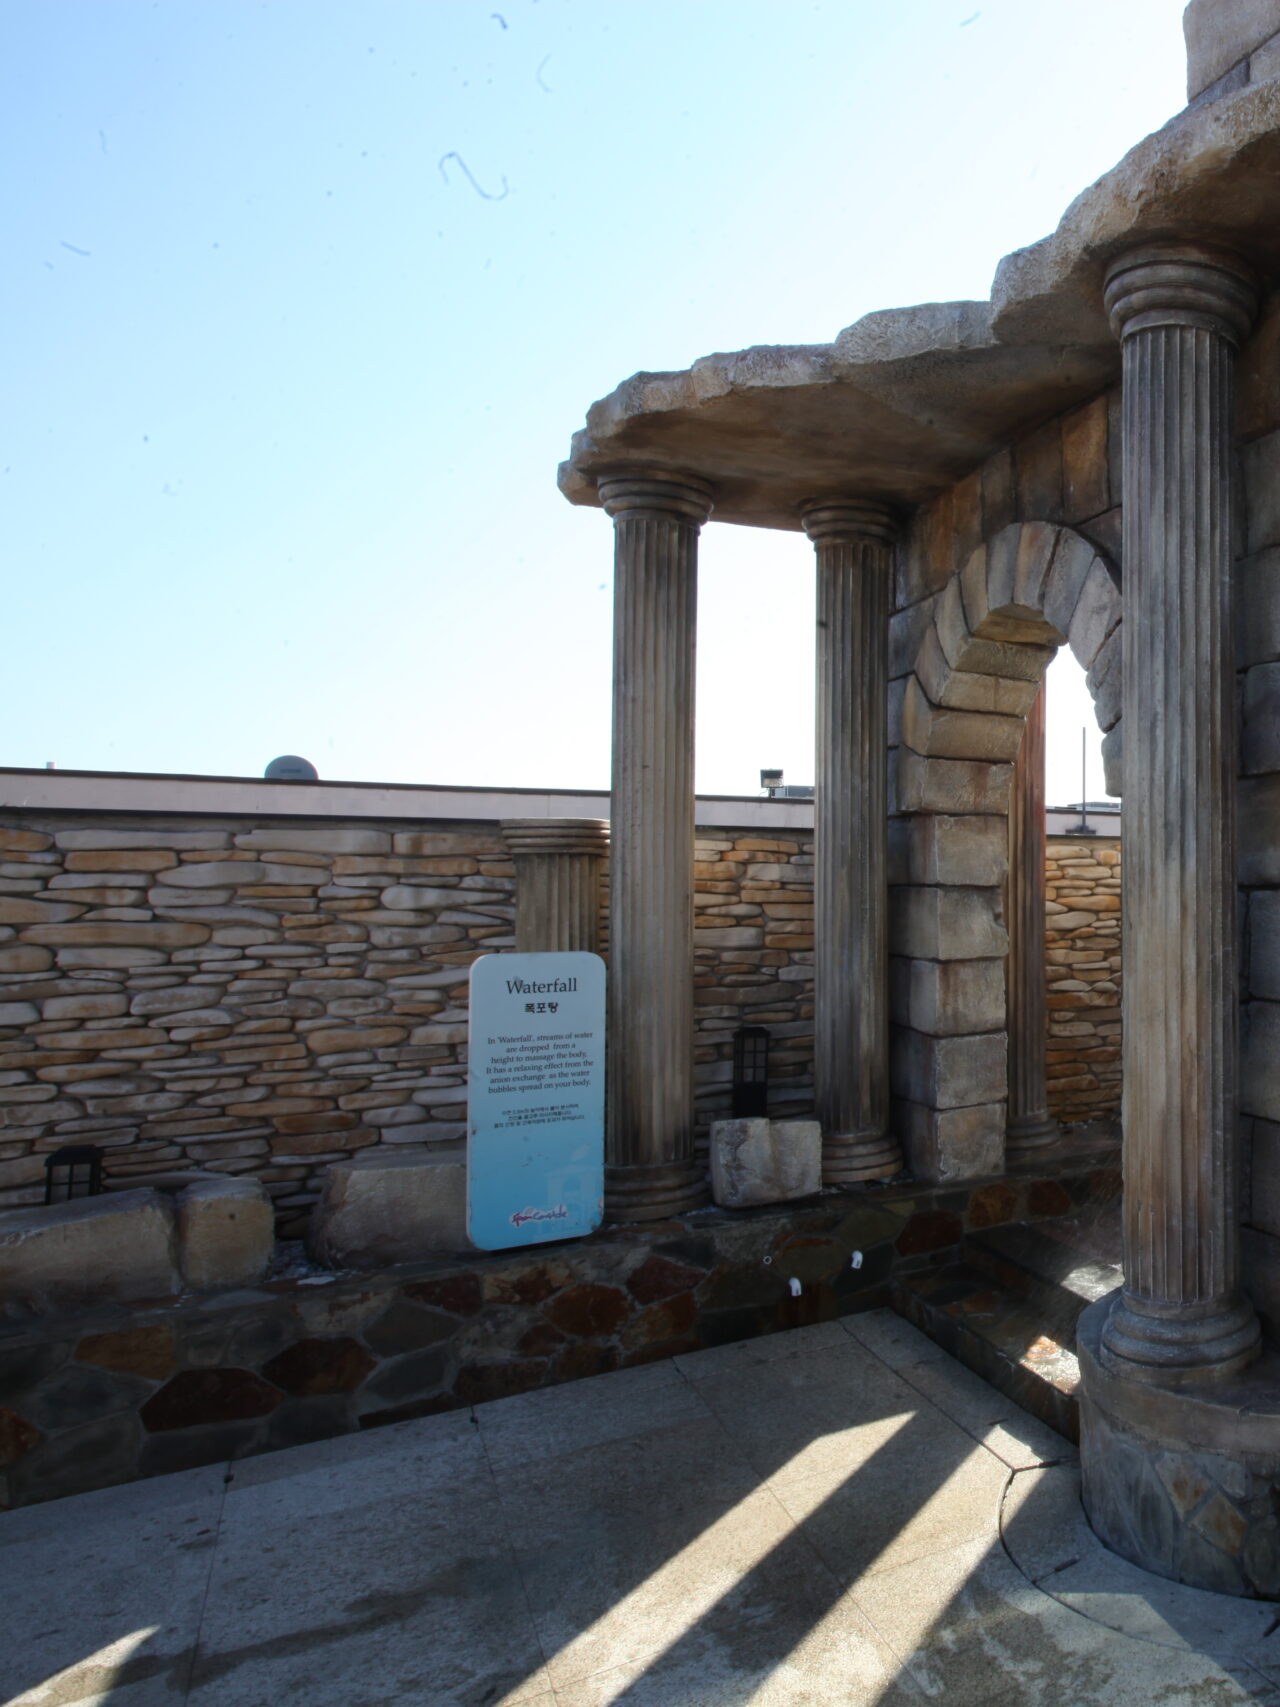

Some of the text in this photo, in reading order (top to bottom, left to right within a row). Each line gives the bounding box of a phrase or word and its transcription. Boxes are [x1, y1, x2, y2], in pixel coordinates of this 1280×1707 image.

[506, 977, 578, 995] Waterfall
[525, 1001, 559, 1014] 폭포탕
[487, 1037, 496, 1045] In
[537, 1033, 564, 1041] streams
[565, 1031, 573, 1039] of
[574, 1031, 593, 1039] water
[519, 1043, 550, 1054] dropped
[553, 1042, 570, 1050] from
[491, 1056, 514, 1065] height
[525, 1053, 555, 1063] massage
[556, 1050, 568, 1059] the
[486, 1067, 492, 1075] It
[493, 1066, 506, 1074] has
[513, 1064, 543, 1074] relaxing
[544, 1062, 563, 1070] effect
[564, 1061, 582, 1069] from
[583, 1060, 594, 1068] the
[490, 1076, 511, 1084] anion
[512, 1073, 546, 1083] exchange
[558, 1071, 569, 1079] the
[570, 1069, 590, 1077] water
[488, 1078, 592, 1094] bubbles spread on your body.
